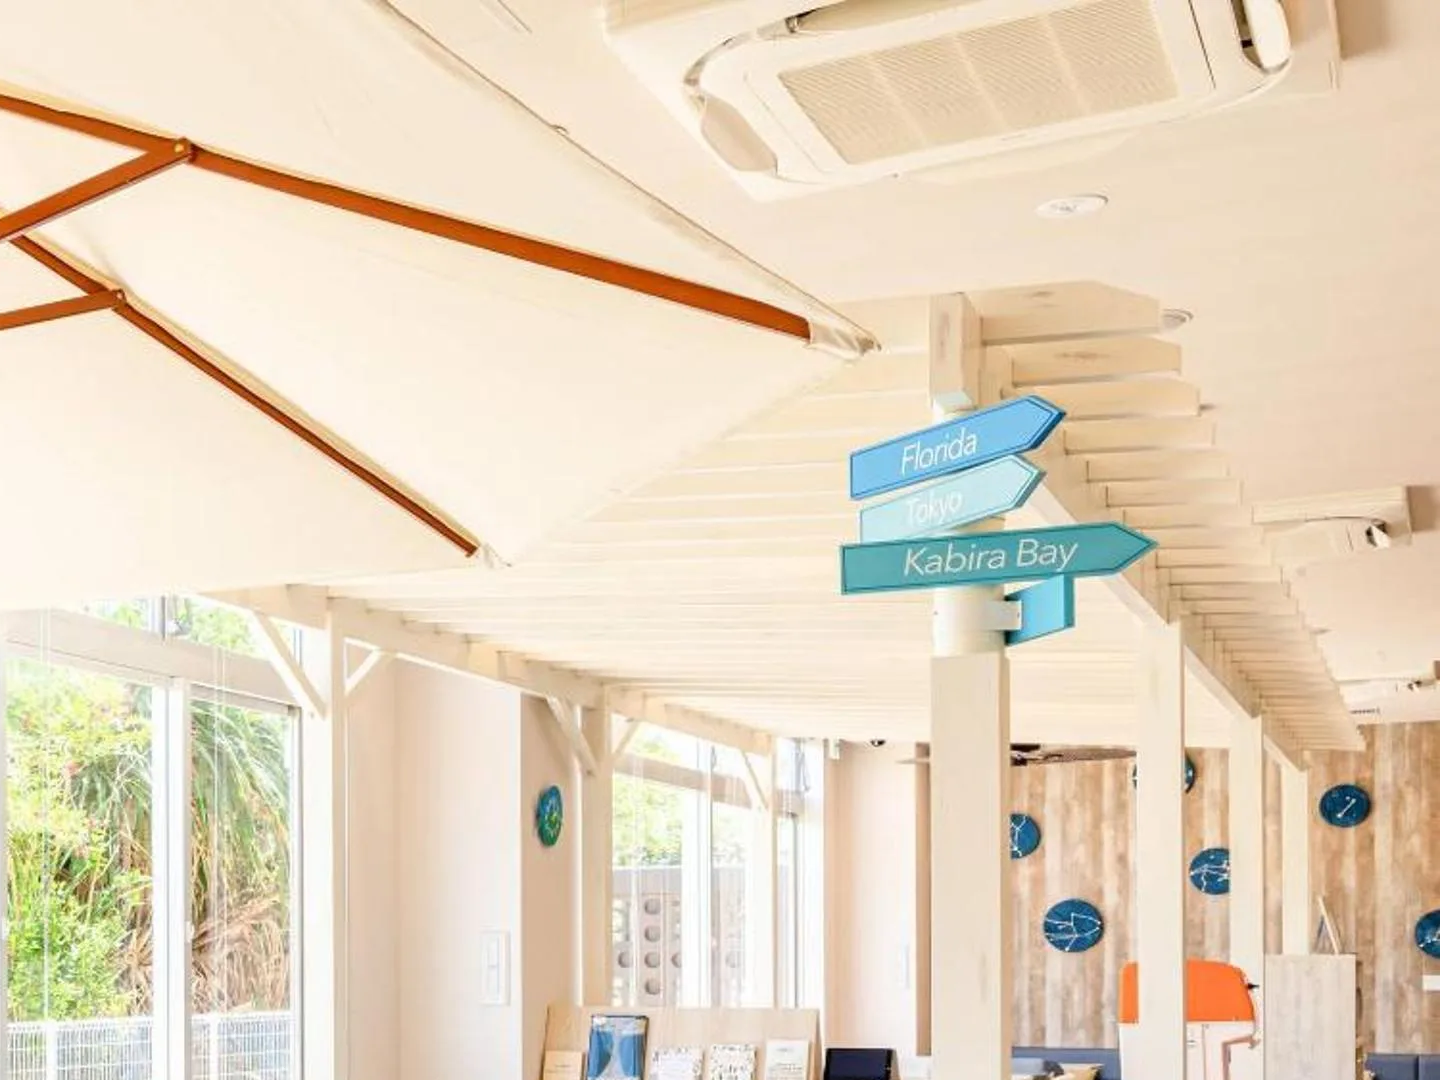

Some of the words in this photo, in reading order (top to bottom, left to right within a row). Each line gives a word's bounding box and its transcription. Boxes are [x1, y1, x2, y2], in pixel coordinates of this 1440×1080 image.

[901, 427, 977, 475] Florida
[906, 491, 963, 527] Tokyo
[903, 541, 1005, 577] Kabira
[1015, 538, 1078, 570] Bay
